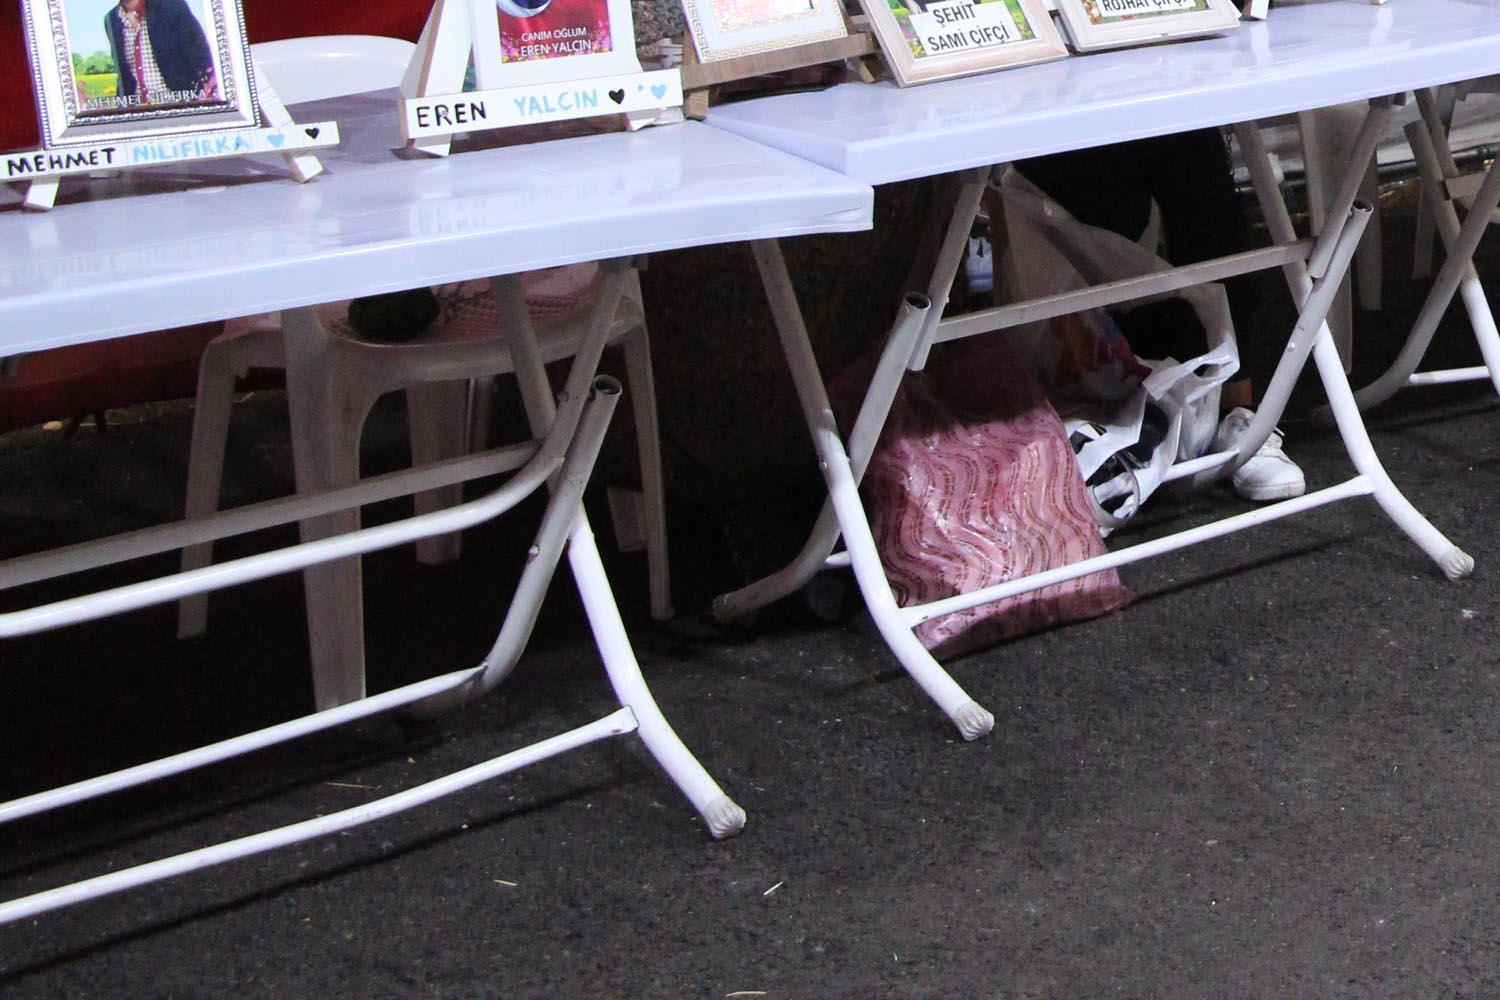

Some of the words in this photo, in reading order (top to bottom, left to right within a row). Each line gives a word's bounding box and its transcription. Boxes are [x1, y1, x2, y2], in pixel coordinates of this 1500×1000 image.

[932, 3, 976, 29] ŞEHİT
[521, 30, 552, 42] CANIM
[553, 26, 587, 38] OĞLUM
[927, 31, 969, 52] SAMİ
[971, 22, 1011, 47] ÇİFÇİ
[520, 43, 550, 57] EREN
[551, 39, 592, 54] YALÇIN
[86, 93, 143, 109] MEHMET
[416, 100, 488, 128] EREN
[513, 88, 599, 117] YALÇIN
[7, 147, 116, 177] MEHMET
